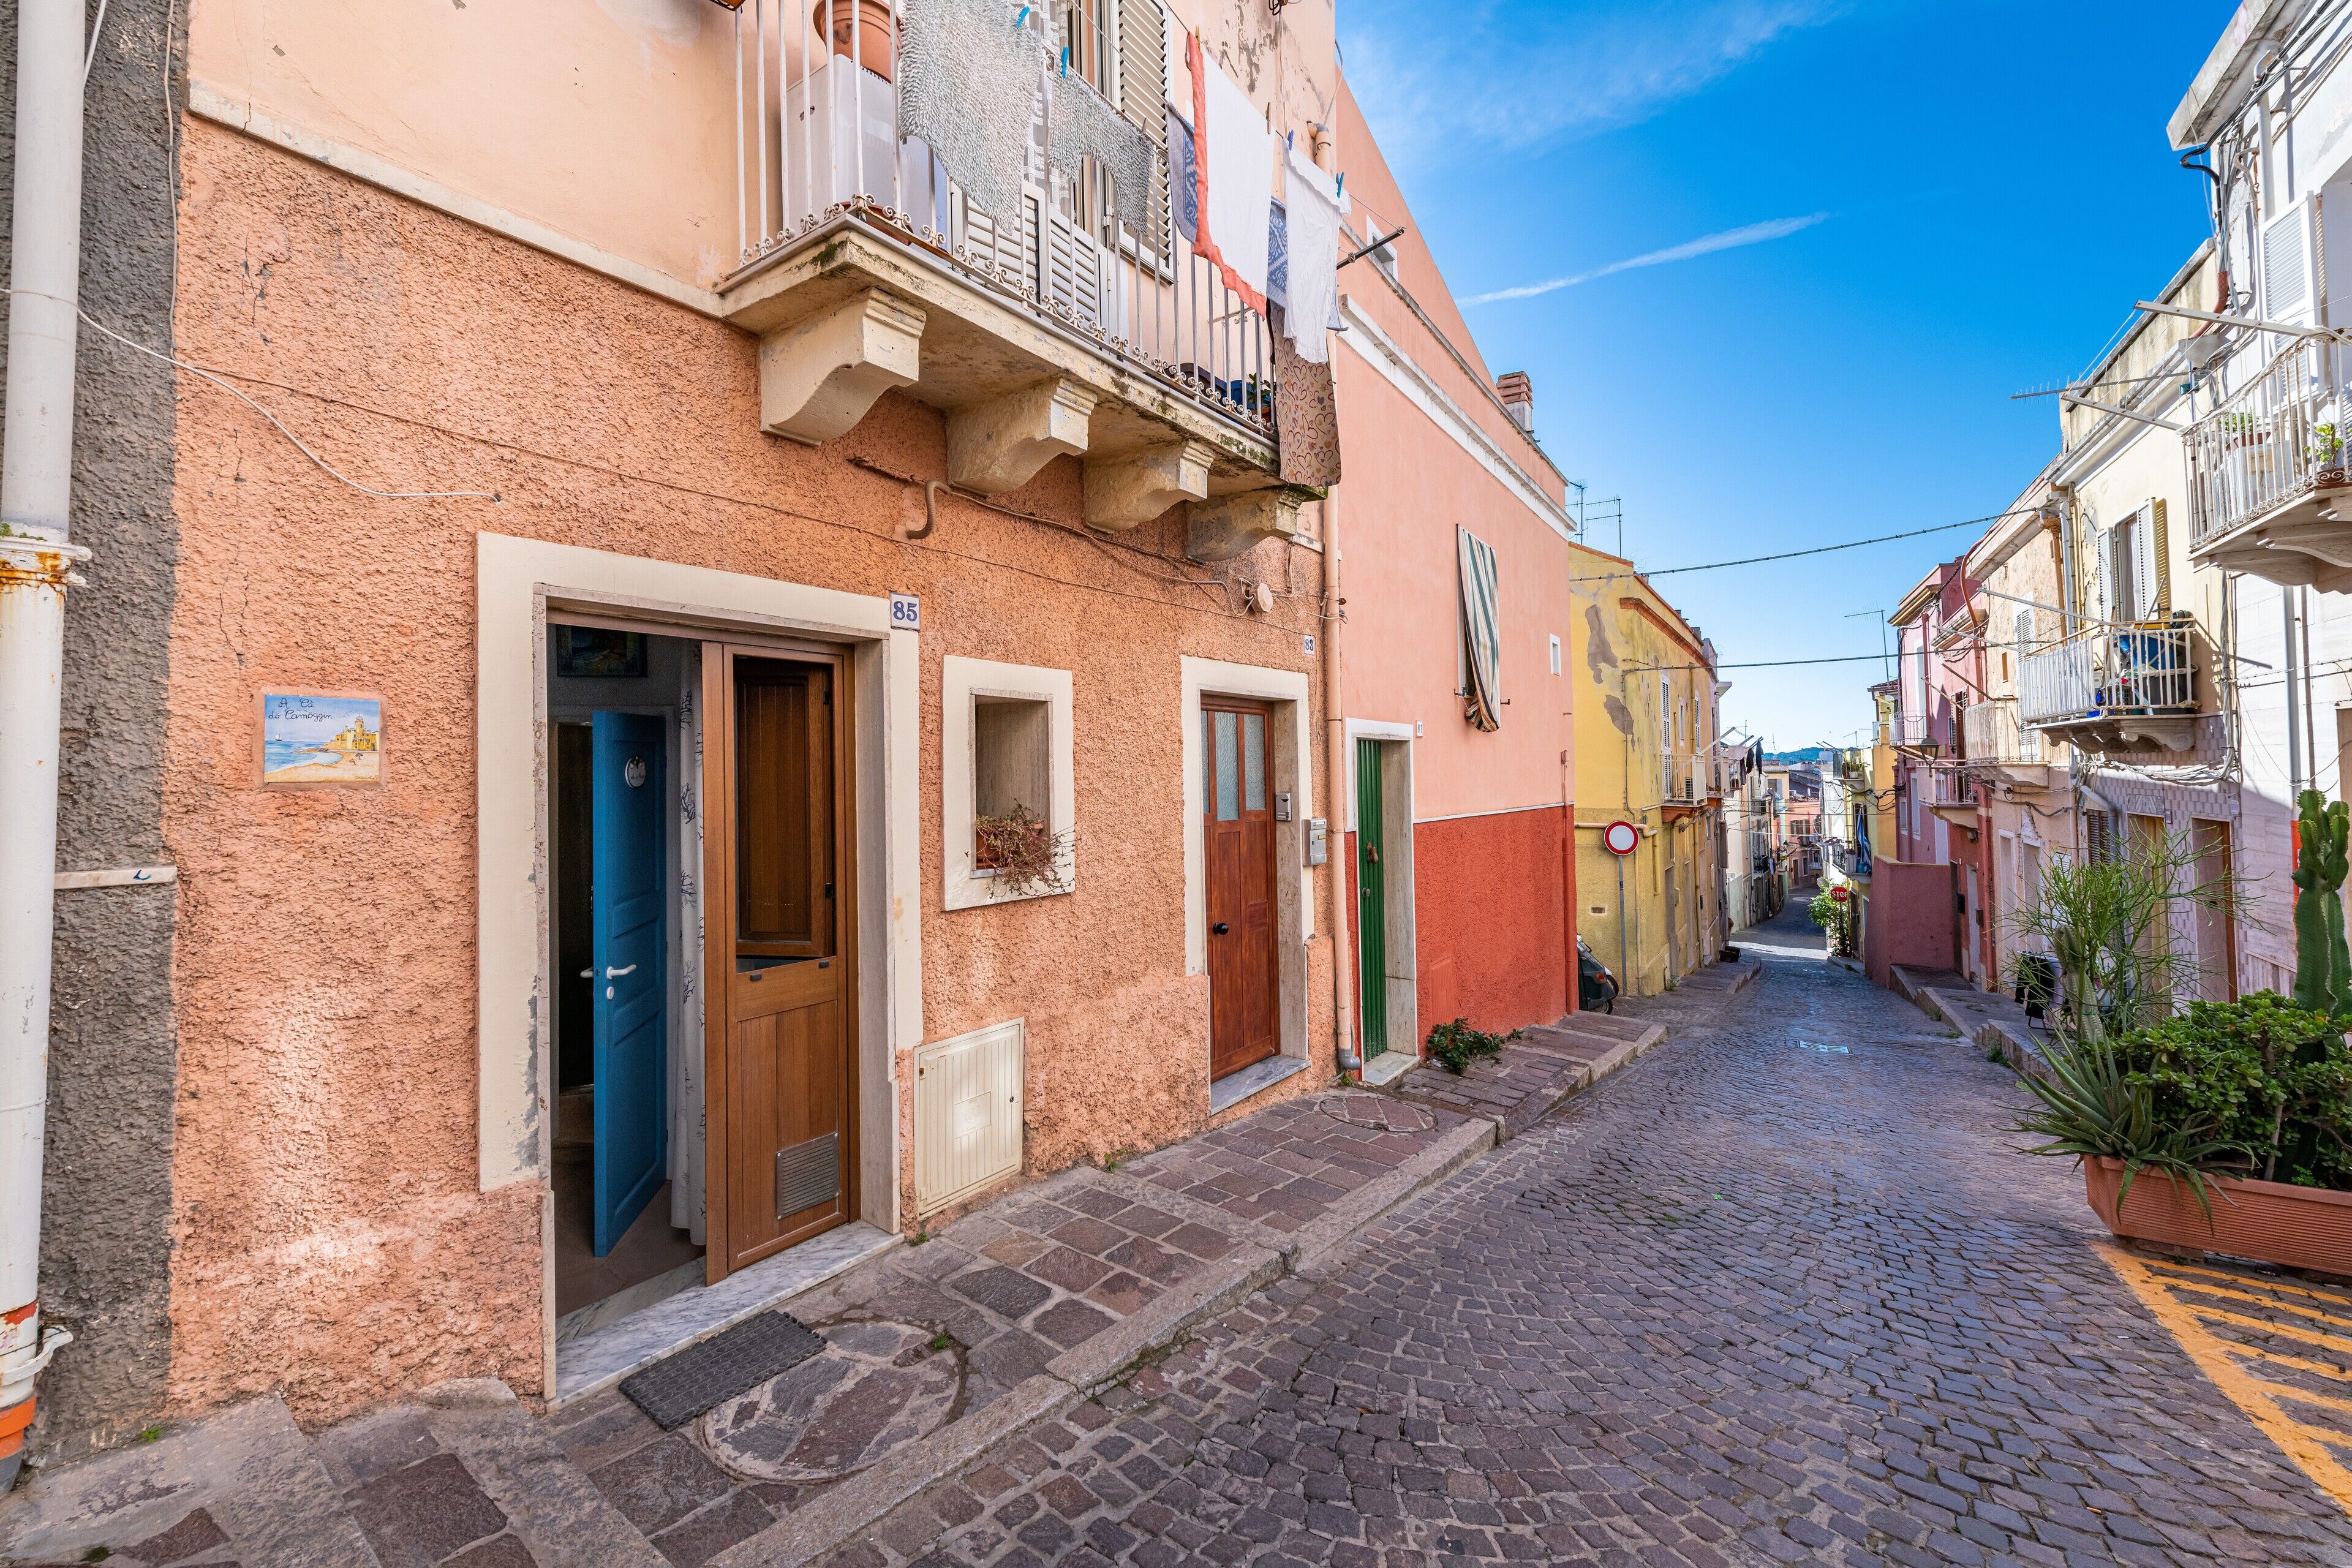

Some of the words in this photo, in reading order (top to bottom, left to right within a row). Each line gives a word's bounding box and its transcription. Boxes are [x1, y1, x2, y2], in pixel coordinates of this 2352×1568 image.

[893, 601, 918, 622] 85
[1305, 639, 1313, 651] 83
[278, 698, 290, 709] A
[1417, 724, 1422, 734] 81
